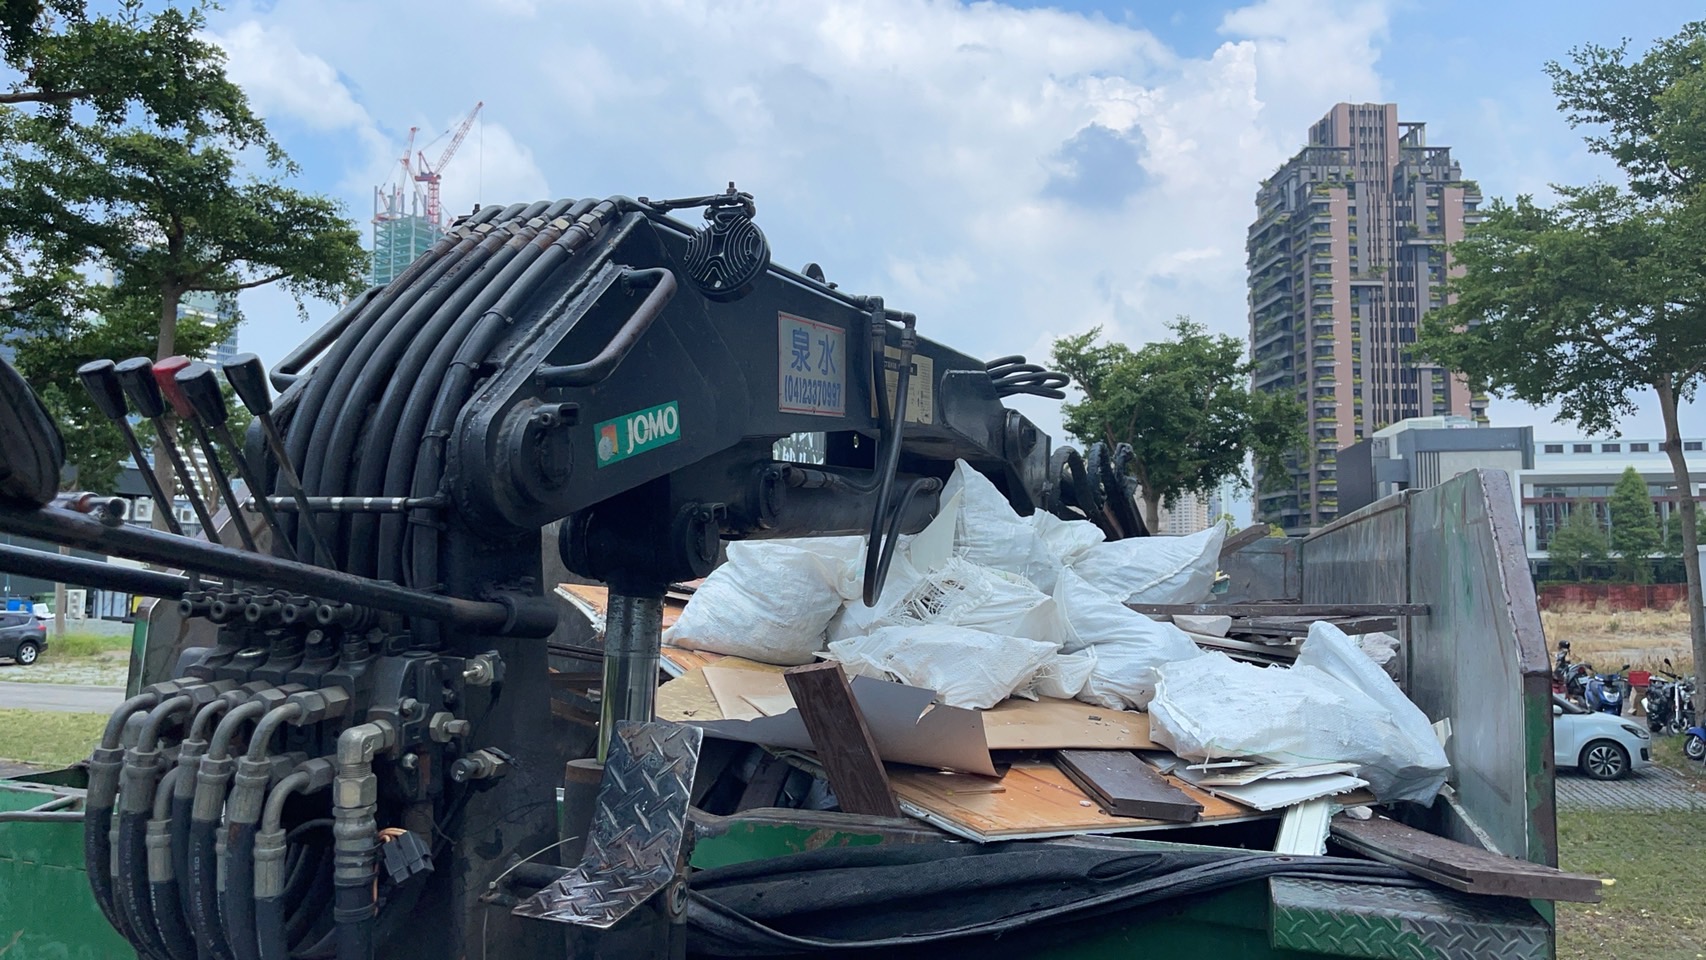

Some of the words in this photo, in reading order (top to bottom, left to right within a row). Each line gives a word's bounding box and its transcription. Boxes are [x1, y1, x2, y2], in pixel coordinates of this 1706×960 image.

[791, 328, 836, 376] 泉水
[784, 374, 841, 407] (04)23370997
[626, 406, 678, 455] JOMO
